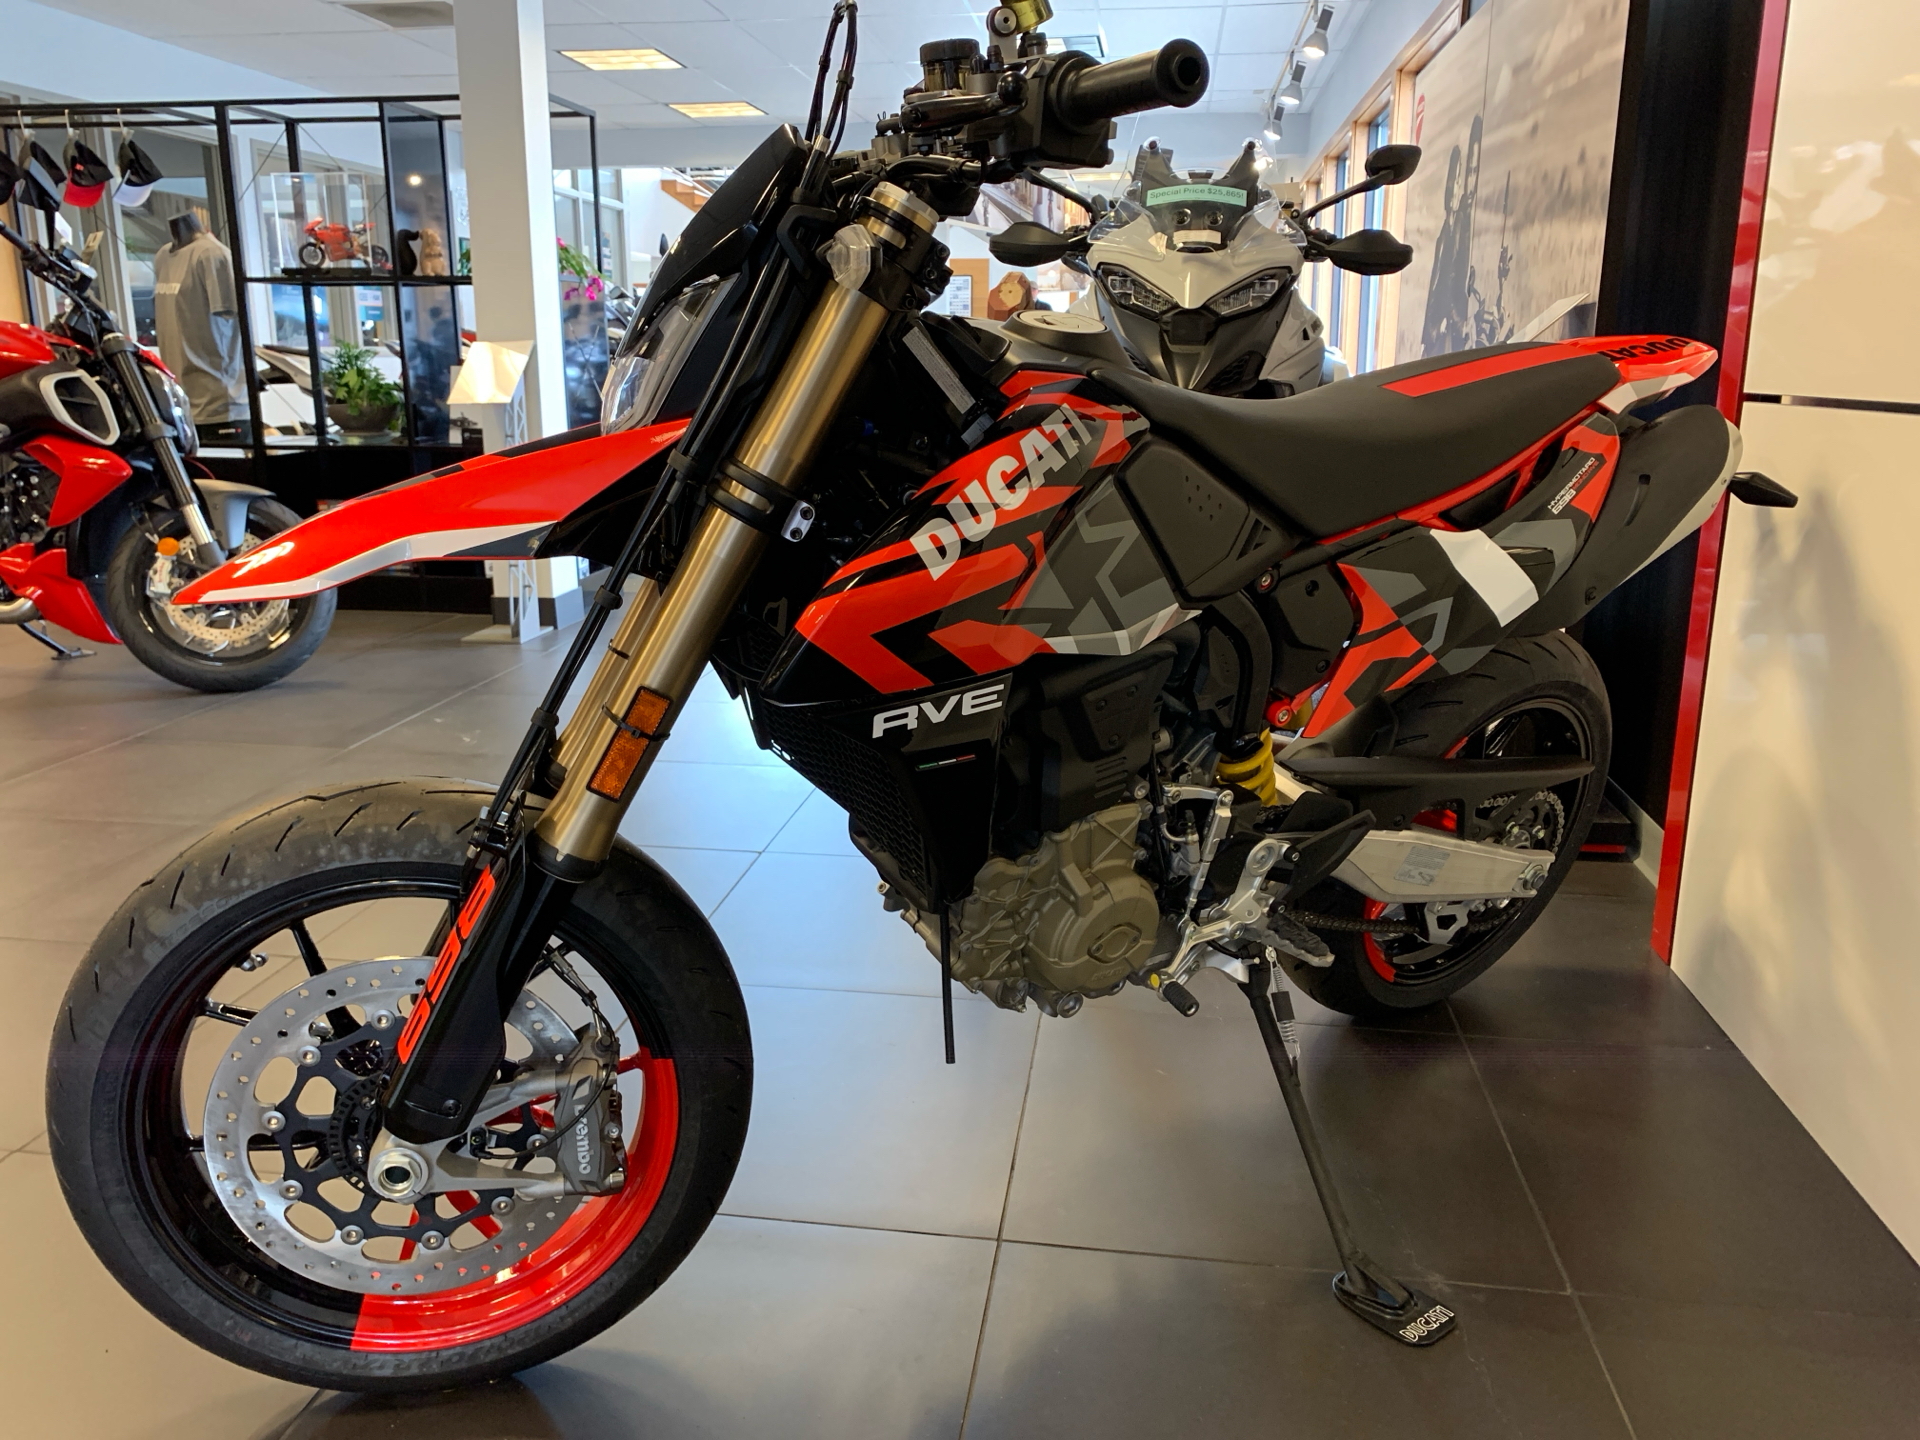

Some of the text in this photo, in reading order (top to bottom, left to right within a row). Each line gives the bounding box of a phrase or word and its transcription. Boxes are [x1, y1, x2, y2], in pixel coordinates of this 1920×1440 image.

[1150, 188, 1181, 199] Special
[1207, 187, 1244, 199] $25,865!
[1597, 337, 1691, 362] DUCAT
[909, 402, 1093, 581] DUCATI
[1547, 457, 1595, 509] HYPERMOTARD
[1552, 488, 1576, 515] 698
[872, 683, 1004, 739] RVE
[574, 1104, 592, 1175] brembo
[1399, 1304, 1455, 1342] DUCATI
